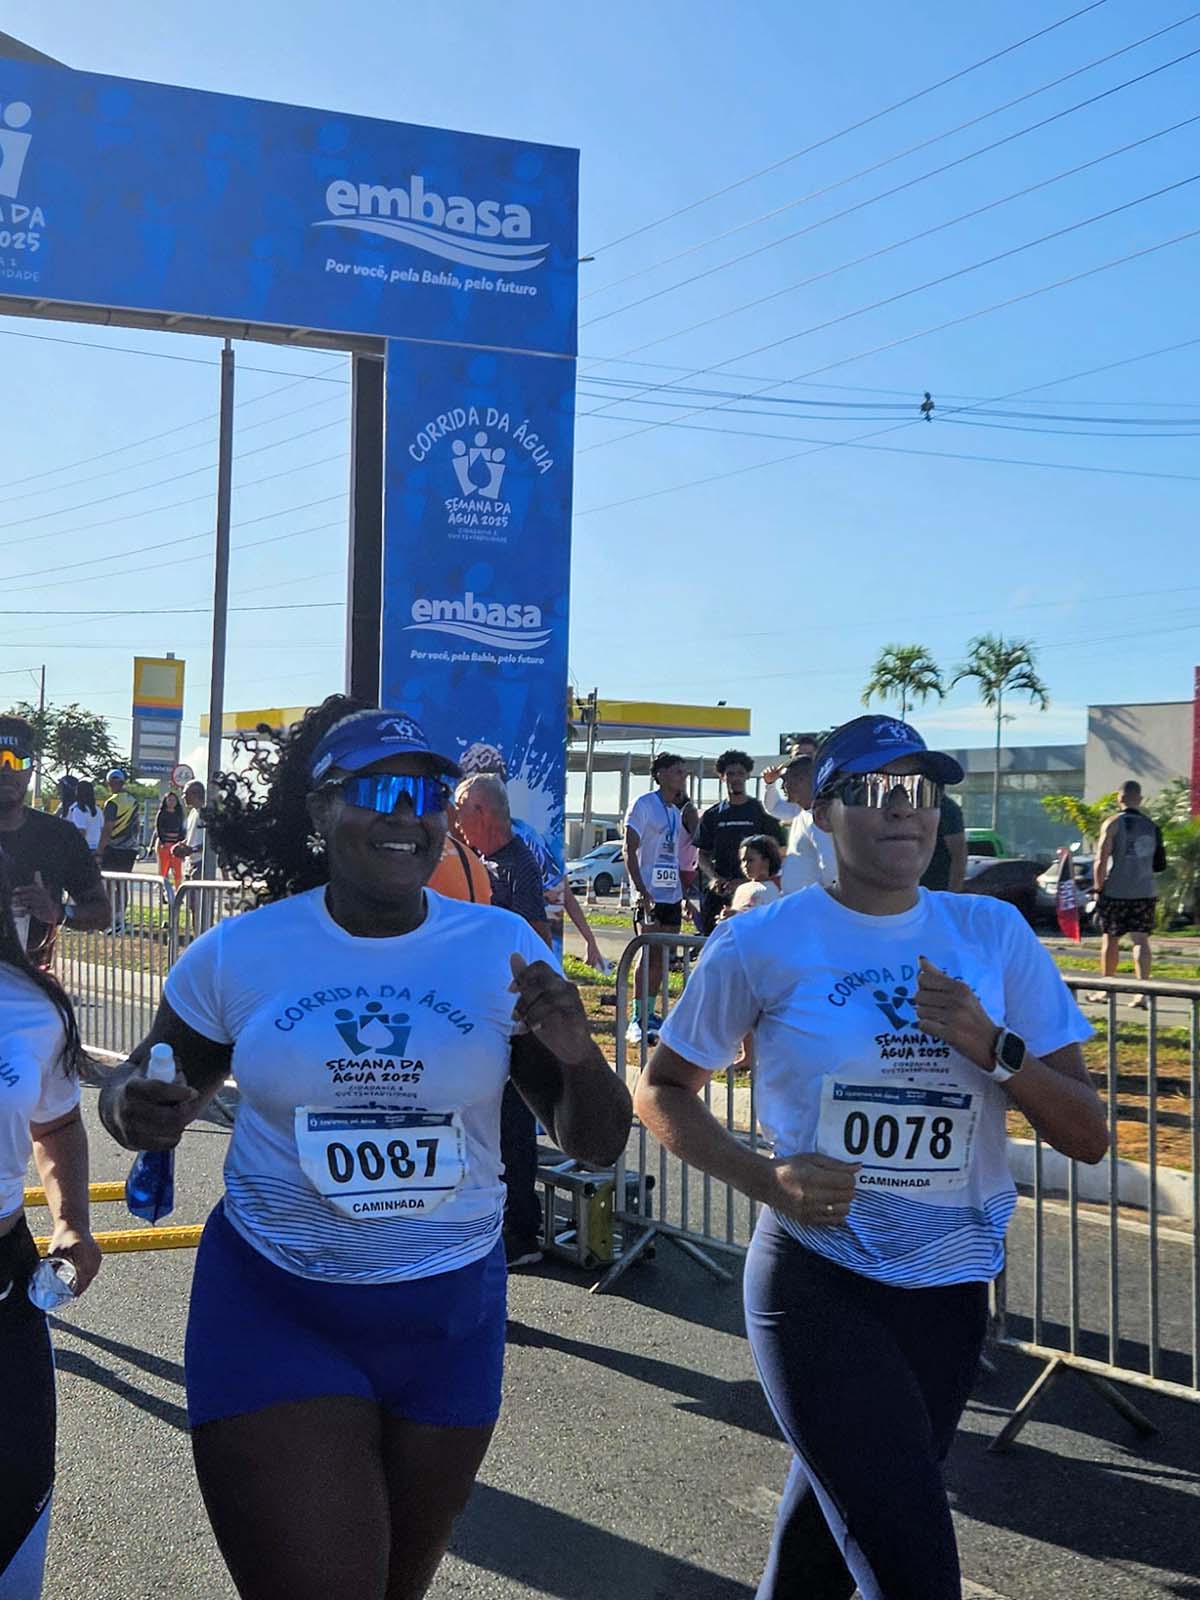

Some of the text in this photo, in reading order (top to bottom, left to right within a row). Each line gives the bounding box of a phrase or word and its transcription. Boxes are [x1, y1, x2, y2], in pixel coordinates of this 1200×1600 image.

[325, 175, 532, 239] embasa
[11, 204, 46, 230] DA
[325, 258, 538, 297] Por você, pela Bahia, pelo futuro
[408, 406, 555, 475] CORRIDA DA ÁGUA
[444, 497, 511, 514] SEMANA DA
[480, 516, 509, 528] 2025
[411, 592, 542, 628] embasa
[410, 650, 427, 659] Por
[498, 653, 517, 665] pelo
[518, 654, 545, 665] futuro
[275, 984, 475, 1036] CORRIDA DA ÁGUA
[874, 1033, 928, 1046] SEMANA
[881, 1044, 951, 1059] ÁGUA 2025
[326, 1058, 424, 1072] SEMANA DA
[333, 1069, 421, 1084] ÁGUA 2025
[844, 1111, 954, 1161] 0078
[326, 1138, 439, 1184] 0087
[859, 1174, 931, 1188] CAMINHADA
[352, 1199, 425, 1214] CAMINHADA
